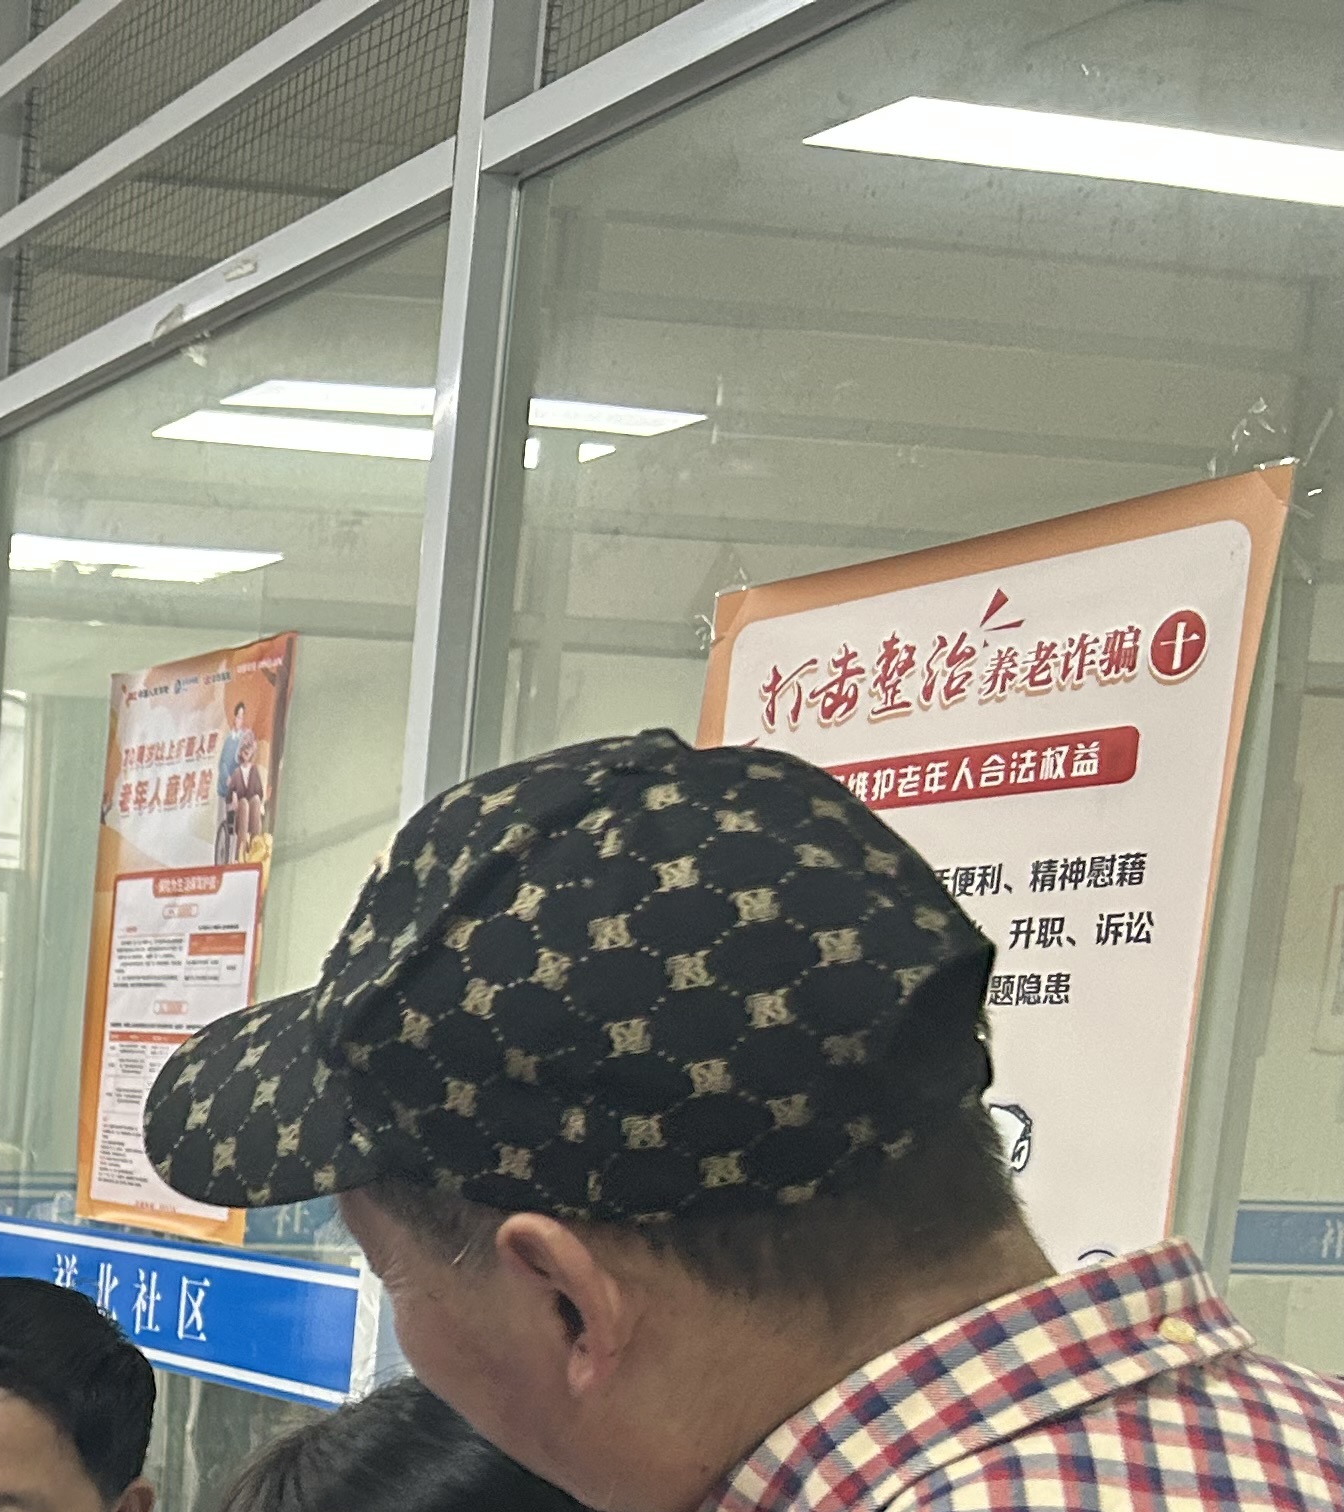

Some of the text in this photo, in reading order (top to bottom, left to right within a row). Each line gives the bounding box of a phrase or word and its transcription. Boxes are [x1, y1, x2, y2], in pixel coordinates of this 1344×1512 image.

[761, 624, 1143, 727] 打击整治养老诈骗
[833, 741, 1101, 802] 维护老年人合法权益
[988, 972, 1071, 1007] 题隐患
